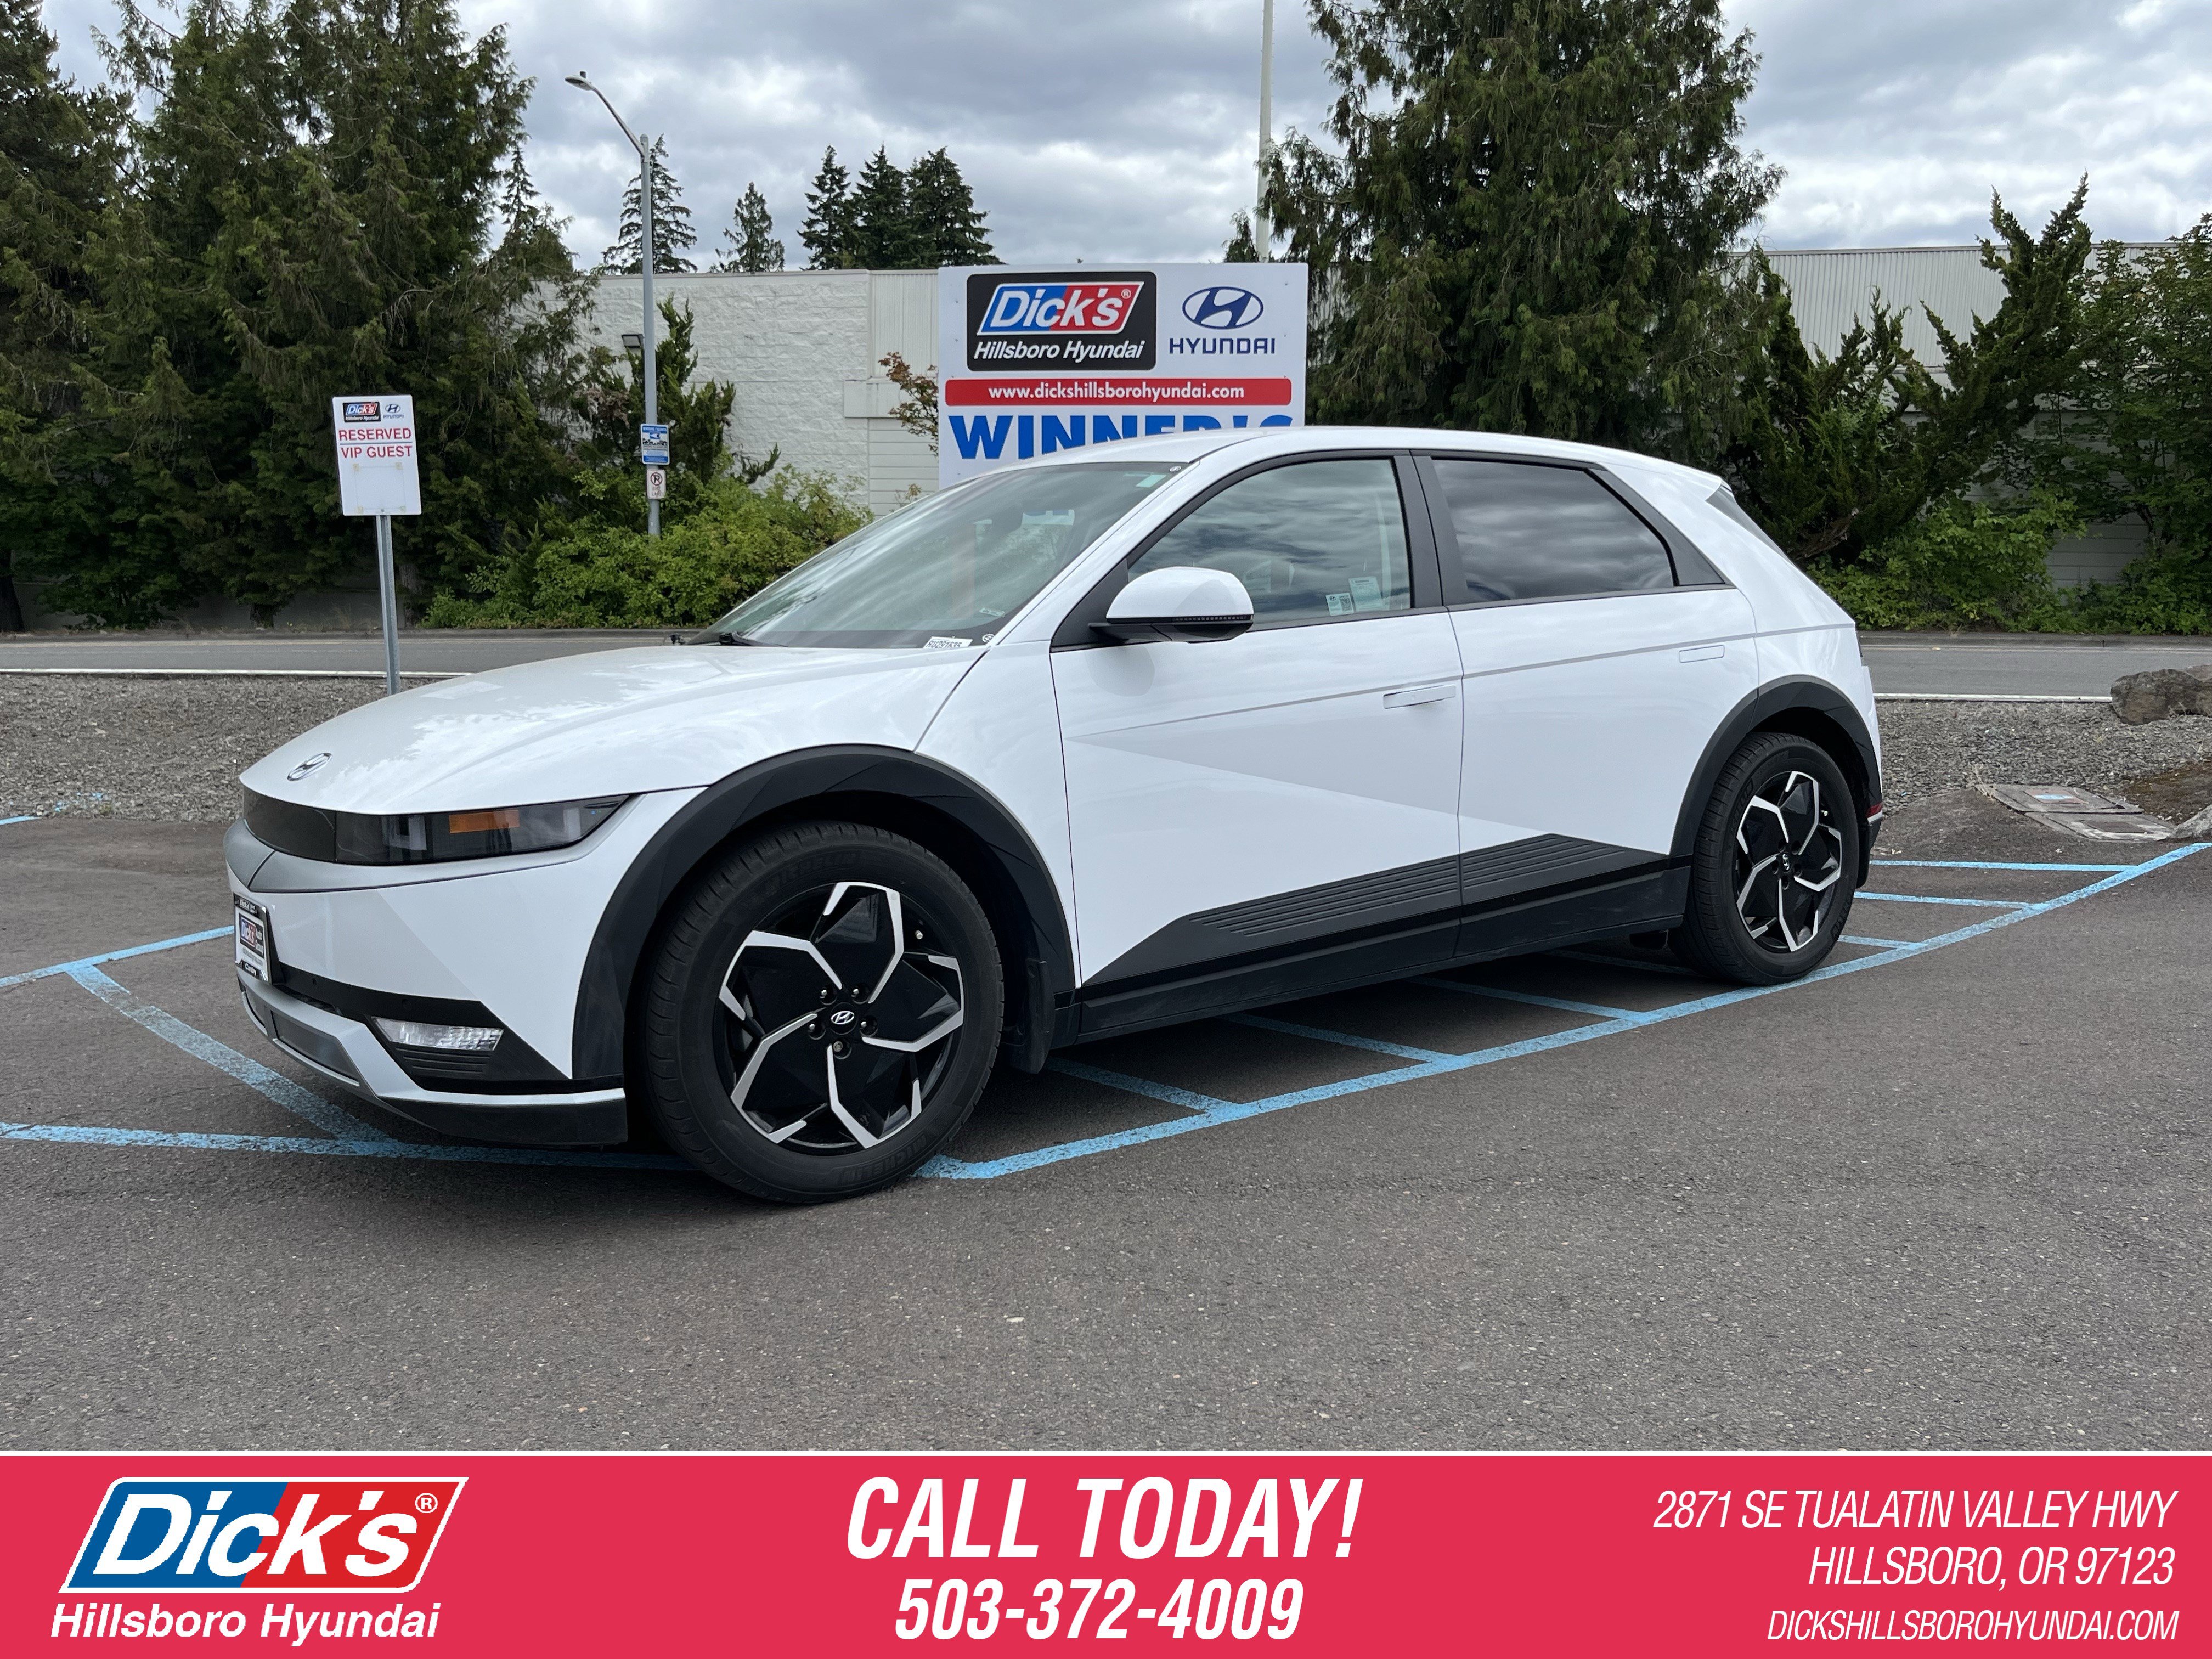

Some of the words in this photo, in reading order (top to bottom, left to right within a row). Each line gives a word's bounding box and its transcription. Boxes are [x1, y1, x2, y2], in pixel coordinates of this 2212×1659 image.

[990, 287, 1124, 328] Dick's
[973, 341, 1060, 359] Hillsboro
[1063, 340, 1146, 363] Hyundai
[1170, 338, 1275, 354] HYUNDAI
[989, 381, 1244, 403] www.dickshillsborohyundai.com
[338, 428, 411, 441] RESERVED
[341, 447, 362, 459] VIP
[366, 445, 413, 458] GUEST
